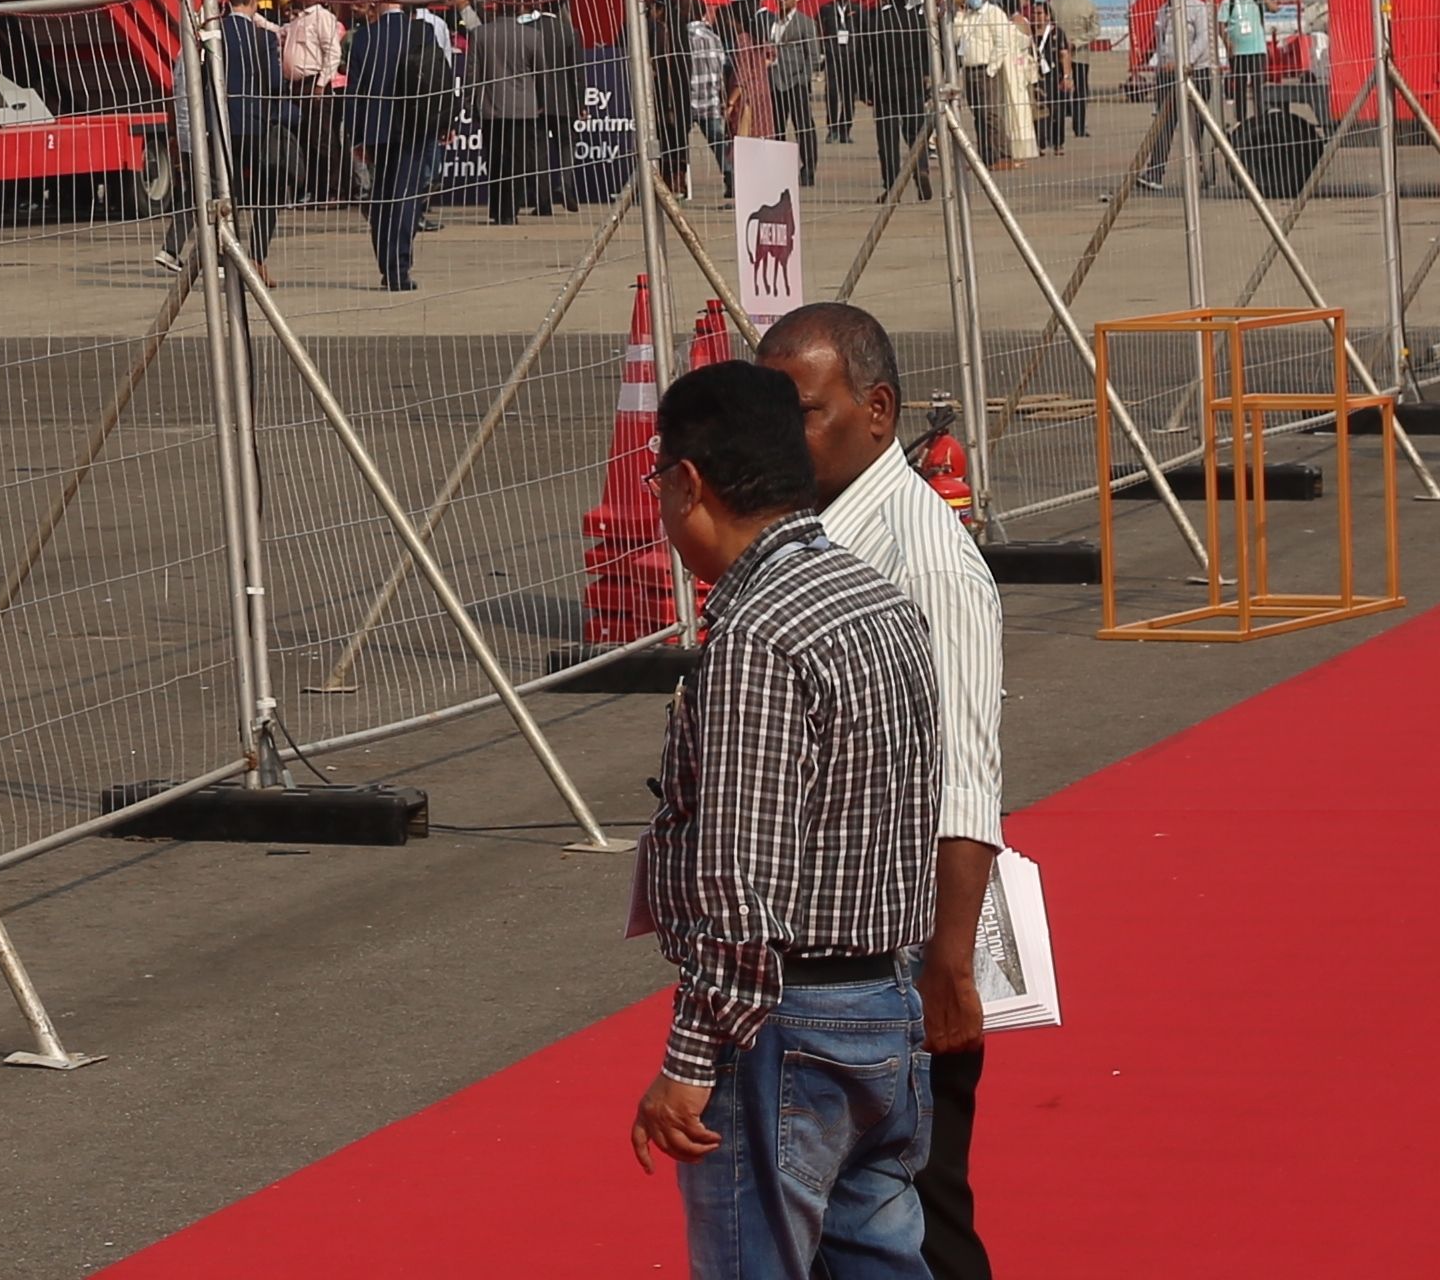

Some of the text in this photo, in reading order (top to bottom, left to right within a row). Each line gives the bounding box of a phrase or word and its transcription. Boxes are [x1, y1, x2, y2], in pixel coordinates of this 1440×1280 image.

[584, 87, 611, 110] By
[48, 133, 55, 150] 2
[445, 129, 482, 151] nd
[574, 141, 619, 164] Only
[438, 156, 488, 178] rink
